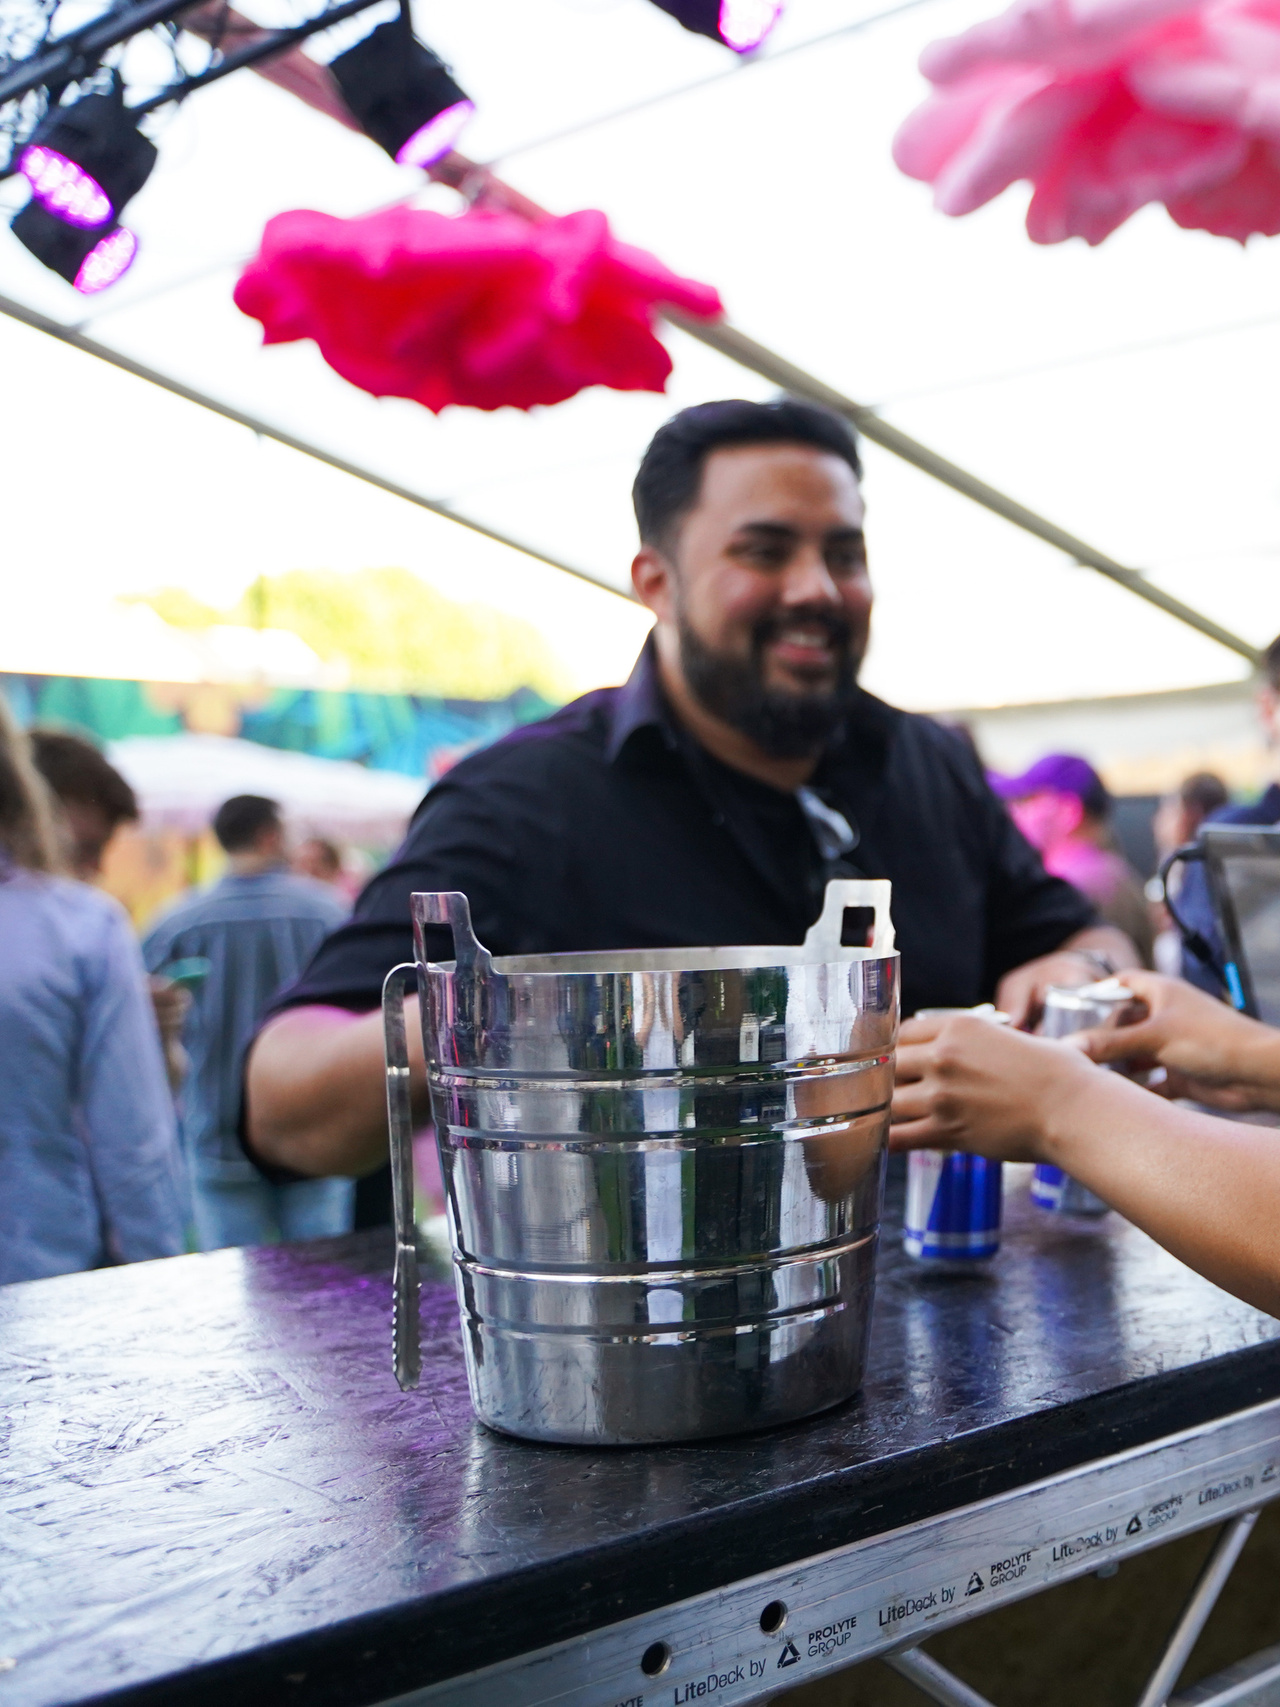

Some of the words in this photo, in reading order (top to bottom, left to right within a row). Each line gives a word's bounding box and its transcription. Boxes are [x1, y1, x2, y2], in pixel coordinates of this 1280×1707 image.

[1106, 1526, 1118, 1542] by
[990, 1551, 1032, 1575] PROLYTE
[990, 1565, 1027, 1587] GROUP
[879, 1591, 937, 1626] LiteDeck
[941, 1586, 955, 1603] by
[808, 1616, 857, 1644] PROLYTE
[808, 1632, 851, 1657] GROUP
[674, 1665, 745, 1705] LiteDeck
[750, 1658, 766, 1677] by
